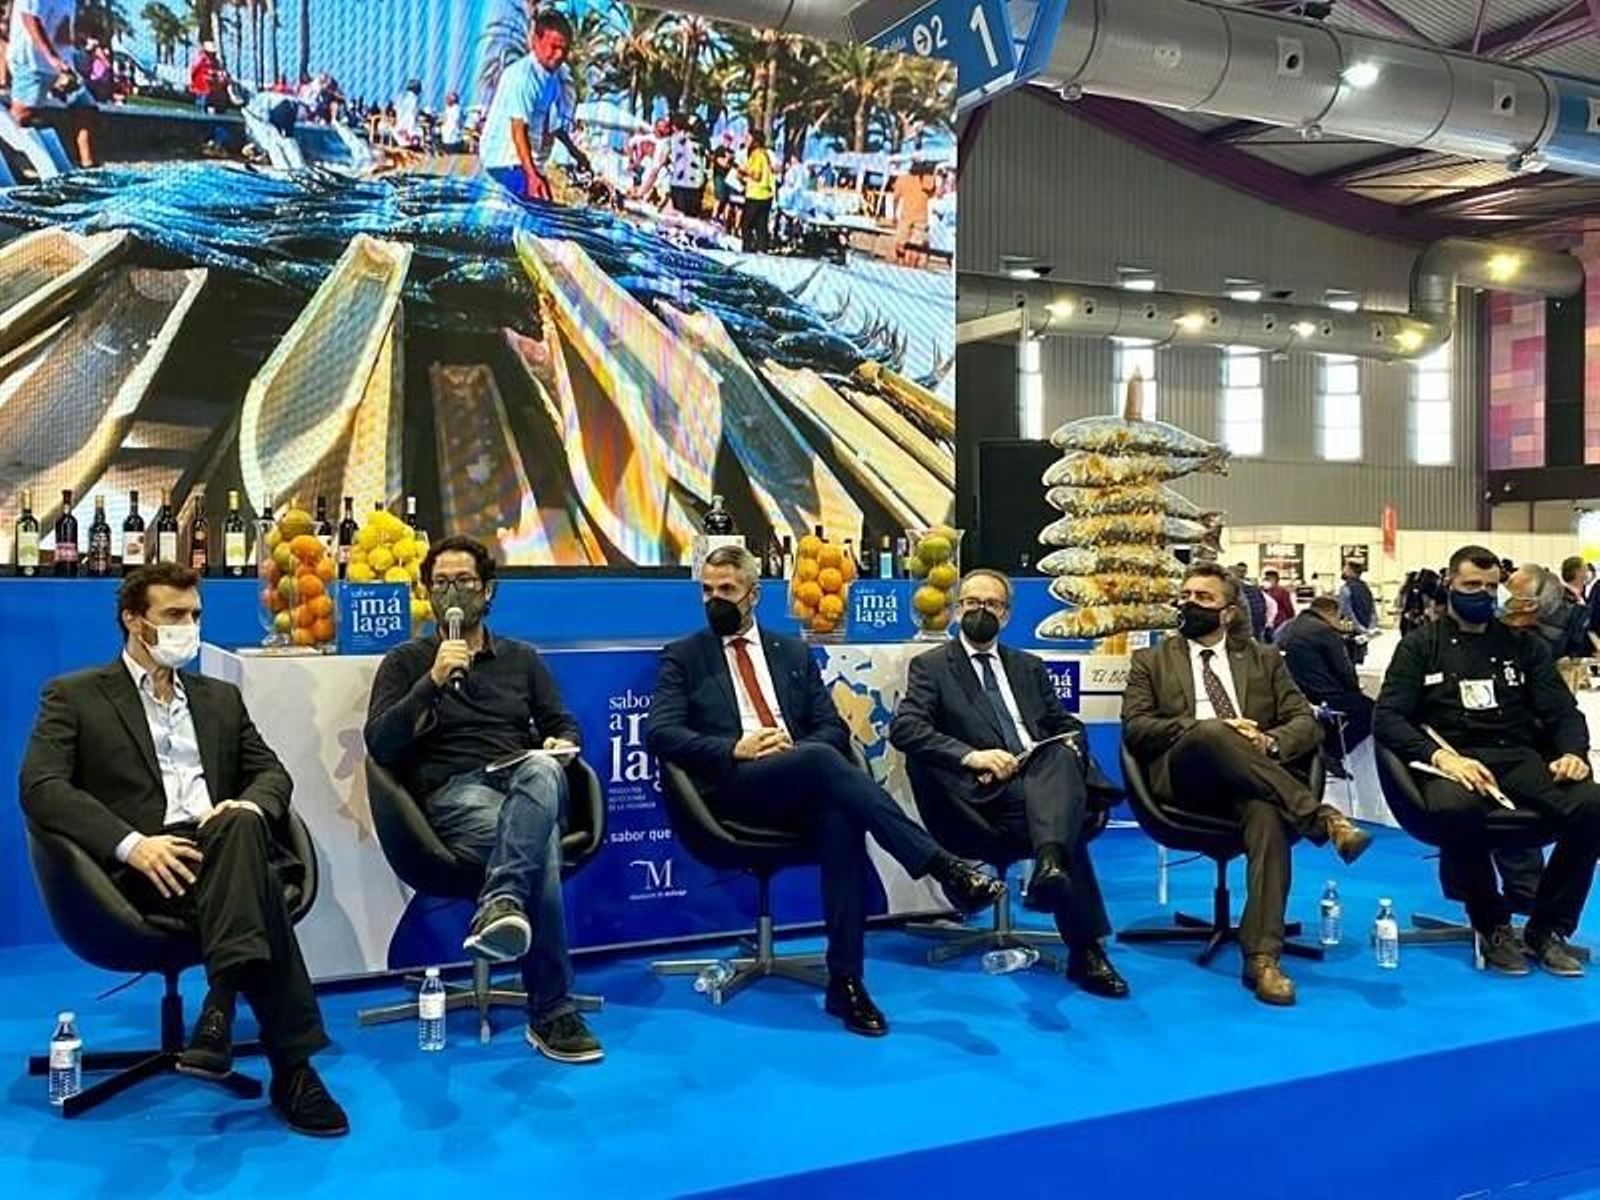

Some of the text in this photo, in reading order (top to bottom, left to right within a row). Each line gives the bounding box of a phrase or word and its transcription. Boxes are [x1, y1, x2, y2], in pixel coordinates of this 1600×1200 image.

[930, 14, 948, 49] 2
[969, 4, 998, 68] 1
[360, 589, 402, 615] má
[862, 588, 898, 609] má
[352, 610, 402, 639] laga
[855, 603, 898, 629] laga
[608, 688, 654, 711] sabo
[609, 712, 624, 732] a
[611, 828, 672, 843] sabor que
